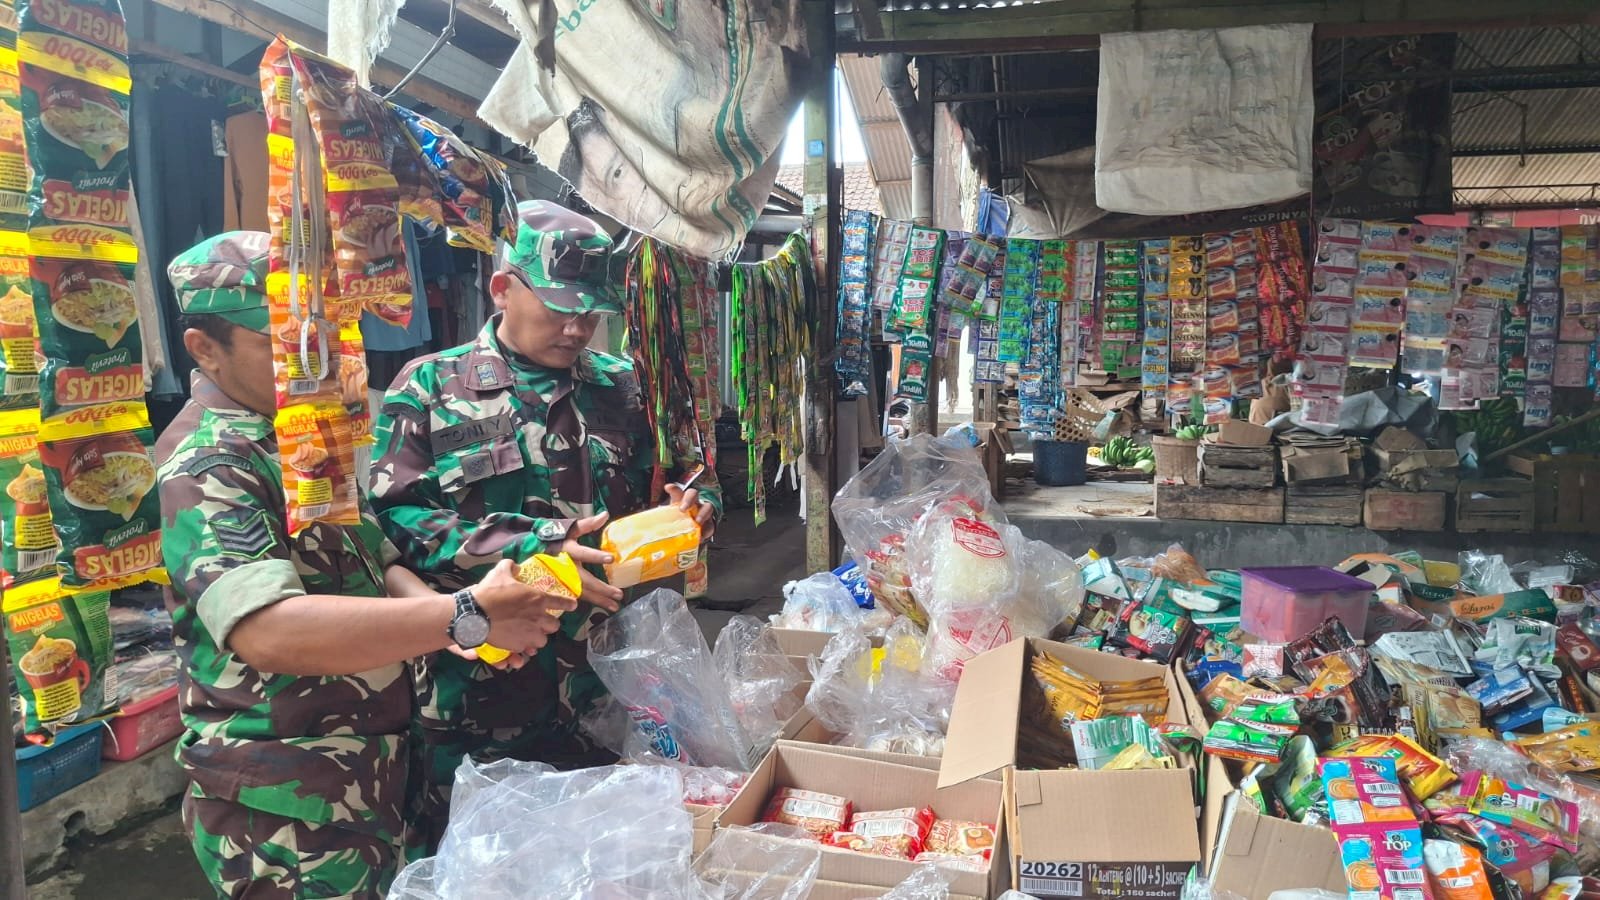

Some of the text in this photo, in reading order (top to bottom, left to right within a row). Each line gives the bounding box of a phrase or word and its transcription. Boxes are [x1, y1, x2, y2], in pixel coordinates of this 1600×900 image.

[1348, 80, 1396, 107] TOP
[1321, 127, 1358, 152] TOP
[1366, 263, 1390, 276] posh
[89, 352, 128, 373] Protevit
[0, 436, 38, 454] MIGELA
[13, 607, 59, 628] MIGELAS
[1360, 762, 1388, 774] TOP
[1383, 840, 1412, 851] TOP
[1022, 863, 1081, 877] 20262
[1088, 863, 1098, 882] 12
[1096, 887, 1120, 896] Total
[1145, 888, 1176, 897] sachet
